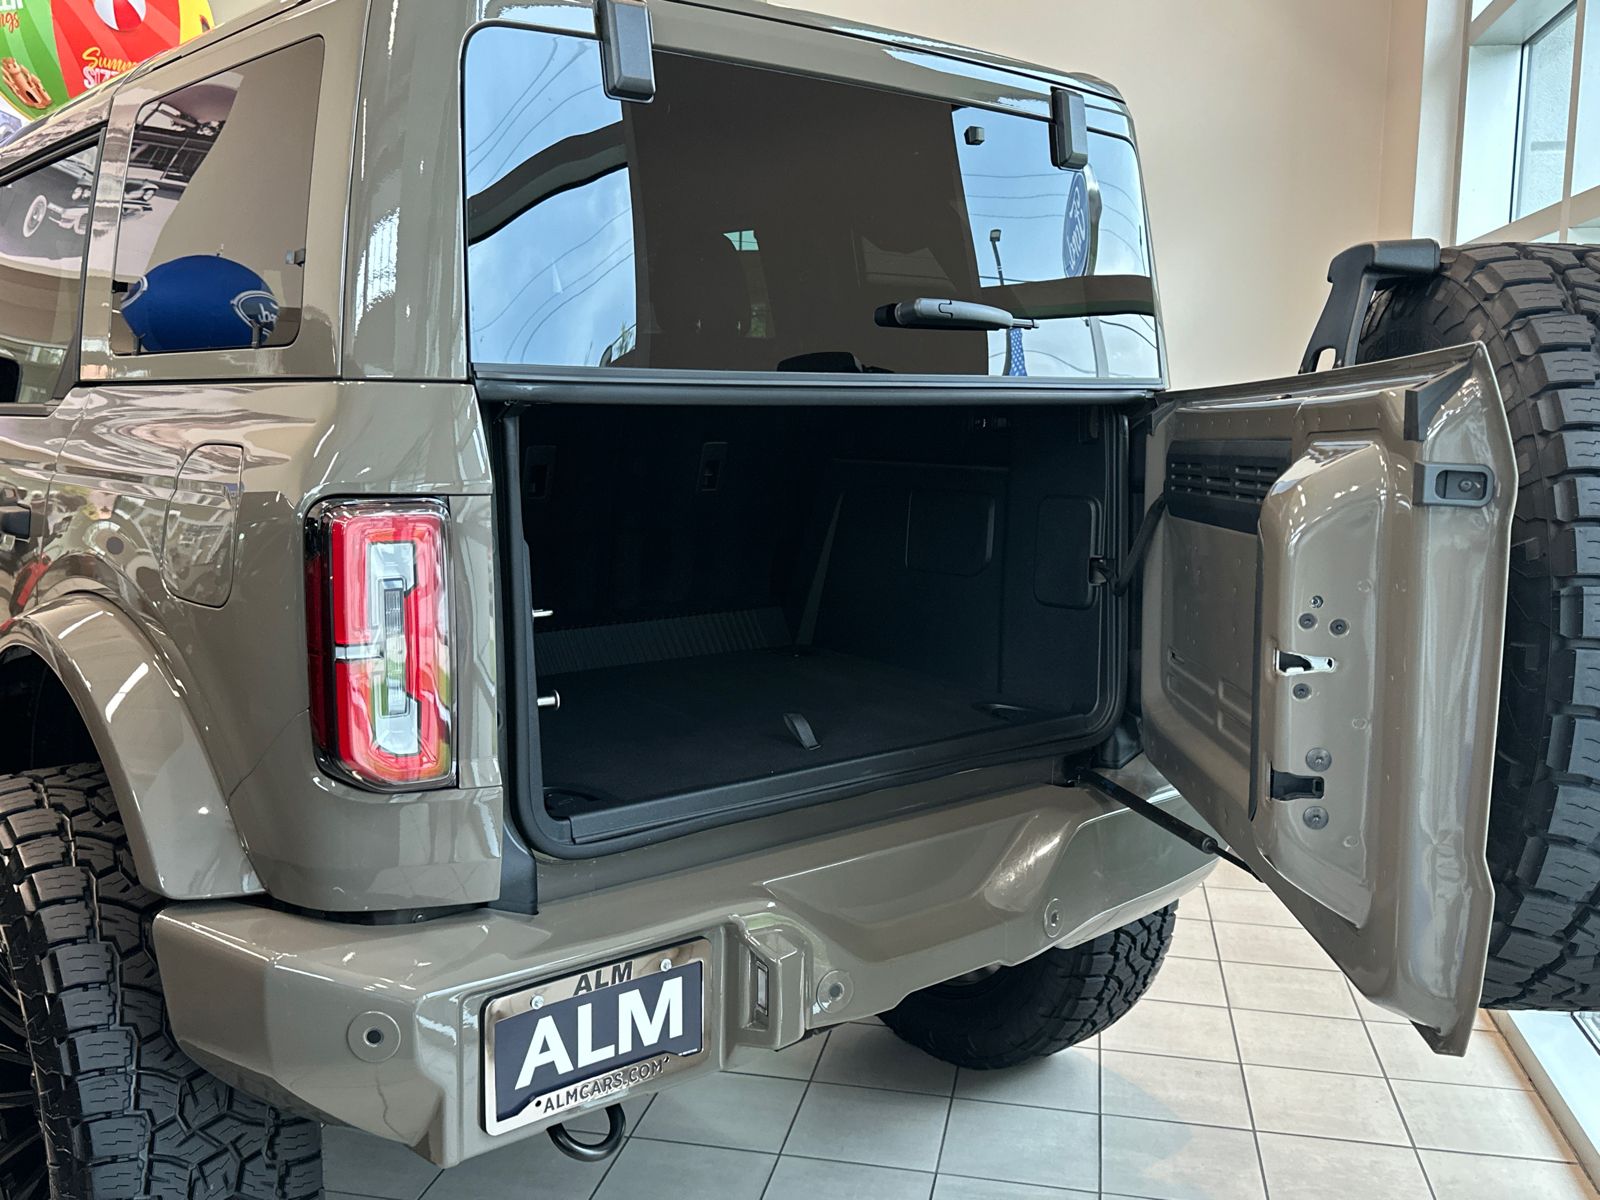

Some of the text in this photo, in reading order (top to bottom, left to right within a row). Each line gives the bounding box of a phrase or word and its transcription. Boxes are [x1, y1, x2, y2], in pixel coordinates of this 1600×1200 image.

[82, 46, 138, 72] Summ
[573, 960, 633, 996] ALM
[515, 976, 683, 1090] ALM
[543, 1060, 664, 1114] ALMCARS.COM
